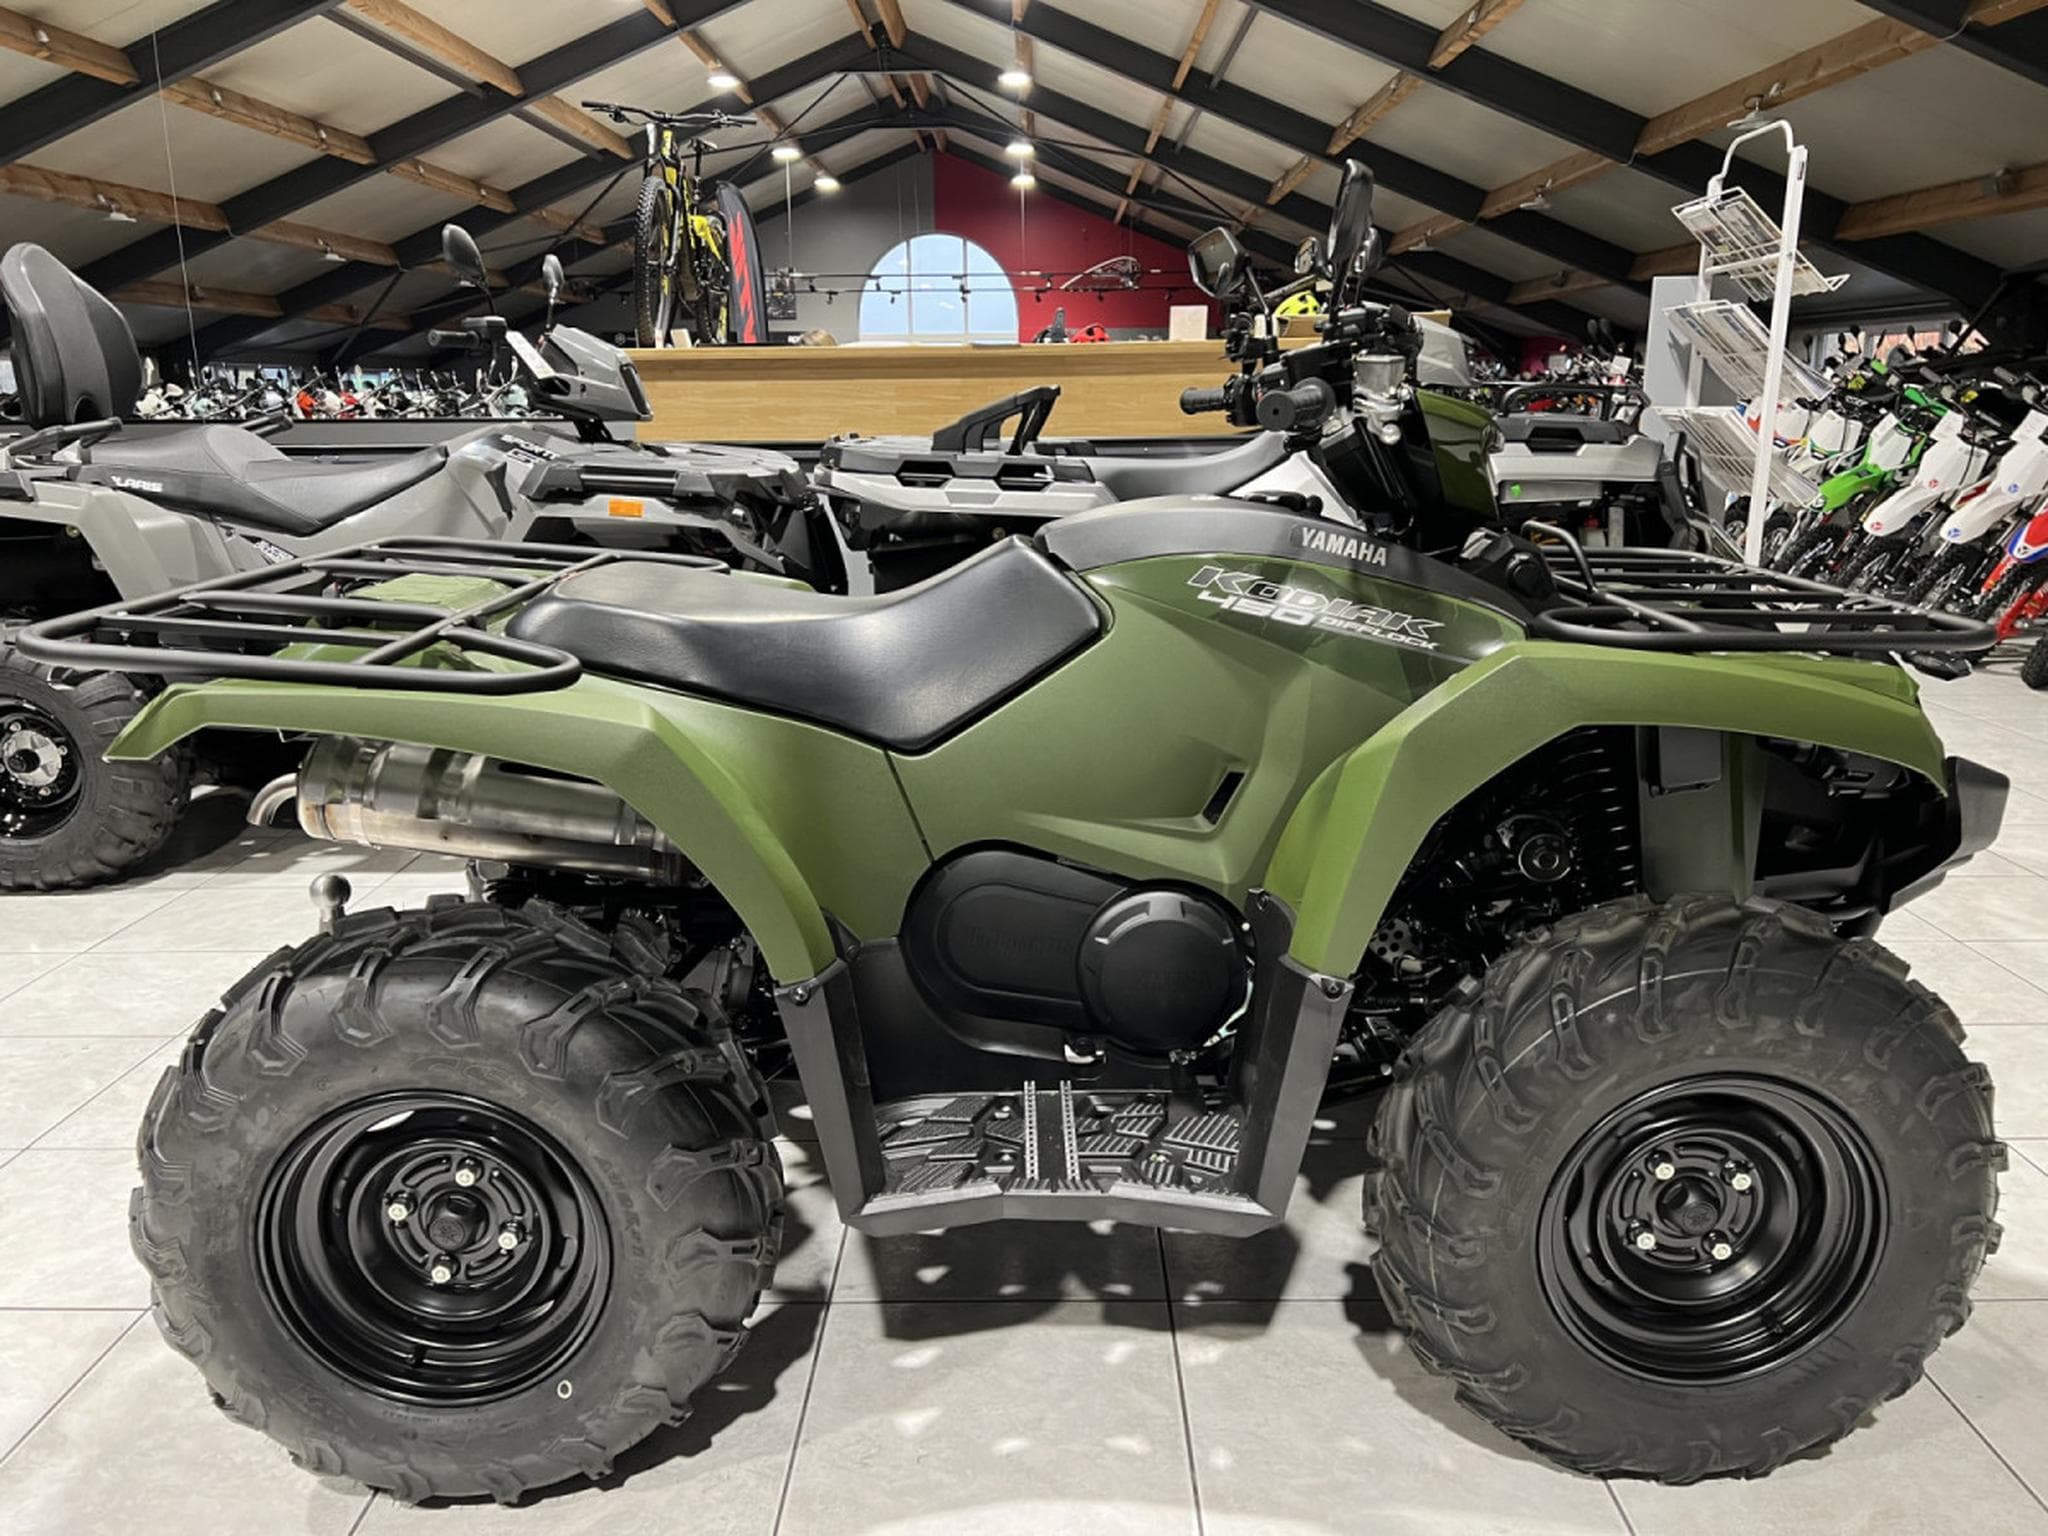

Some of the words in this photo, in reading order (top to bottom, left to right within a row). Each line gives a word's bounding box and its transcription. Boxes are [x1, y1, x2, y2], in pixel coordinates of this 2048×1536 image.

[1301, 526, 1388, 567] YAMAHA
[1186, 564, 1446, 640] KODIAK
[1196, 589, 1318, 626] 450
